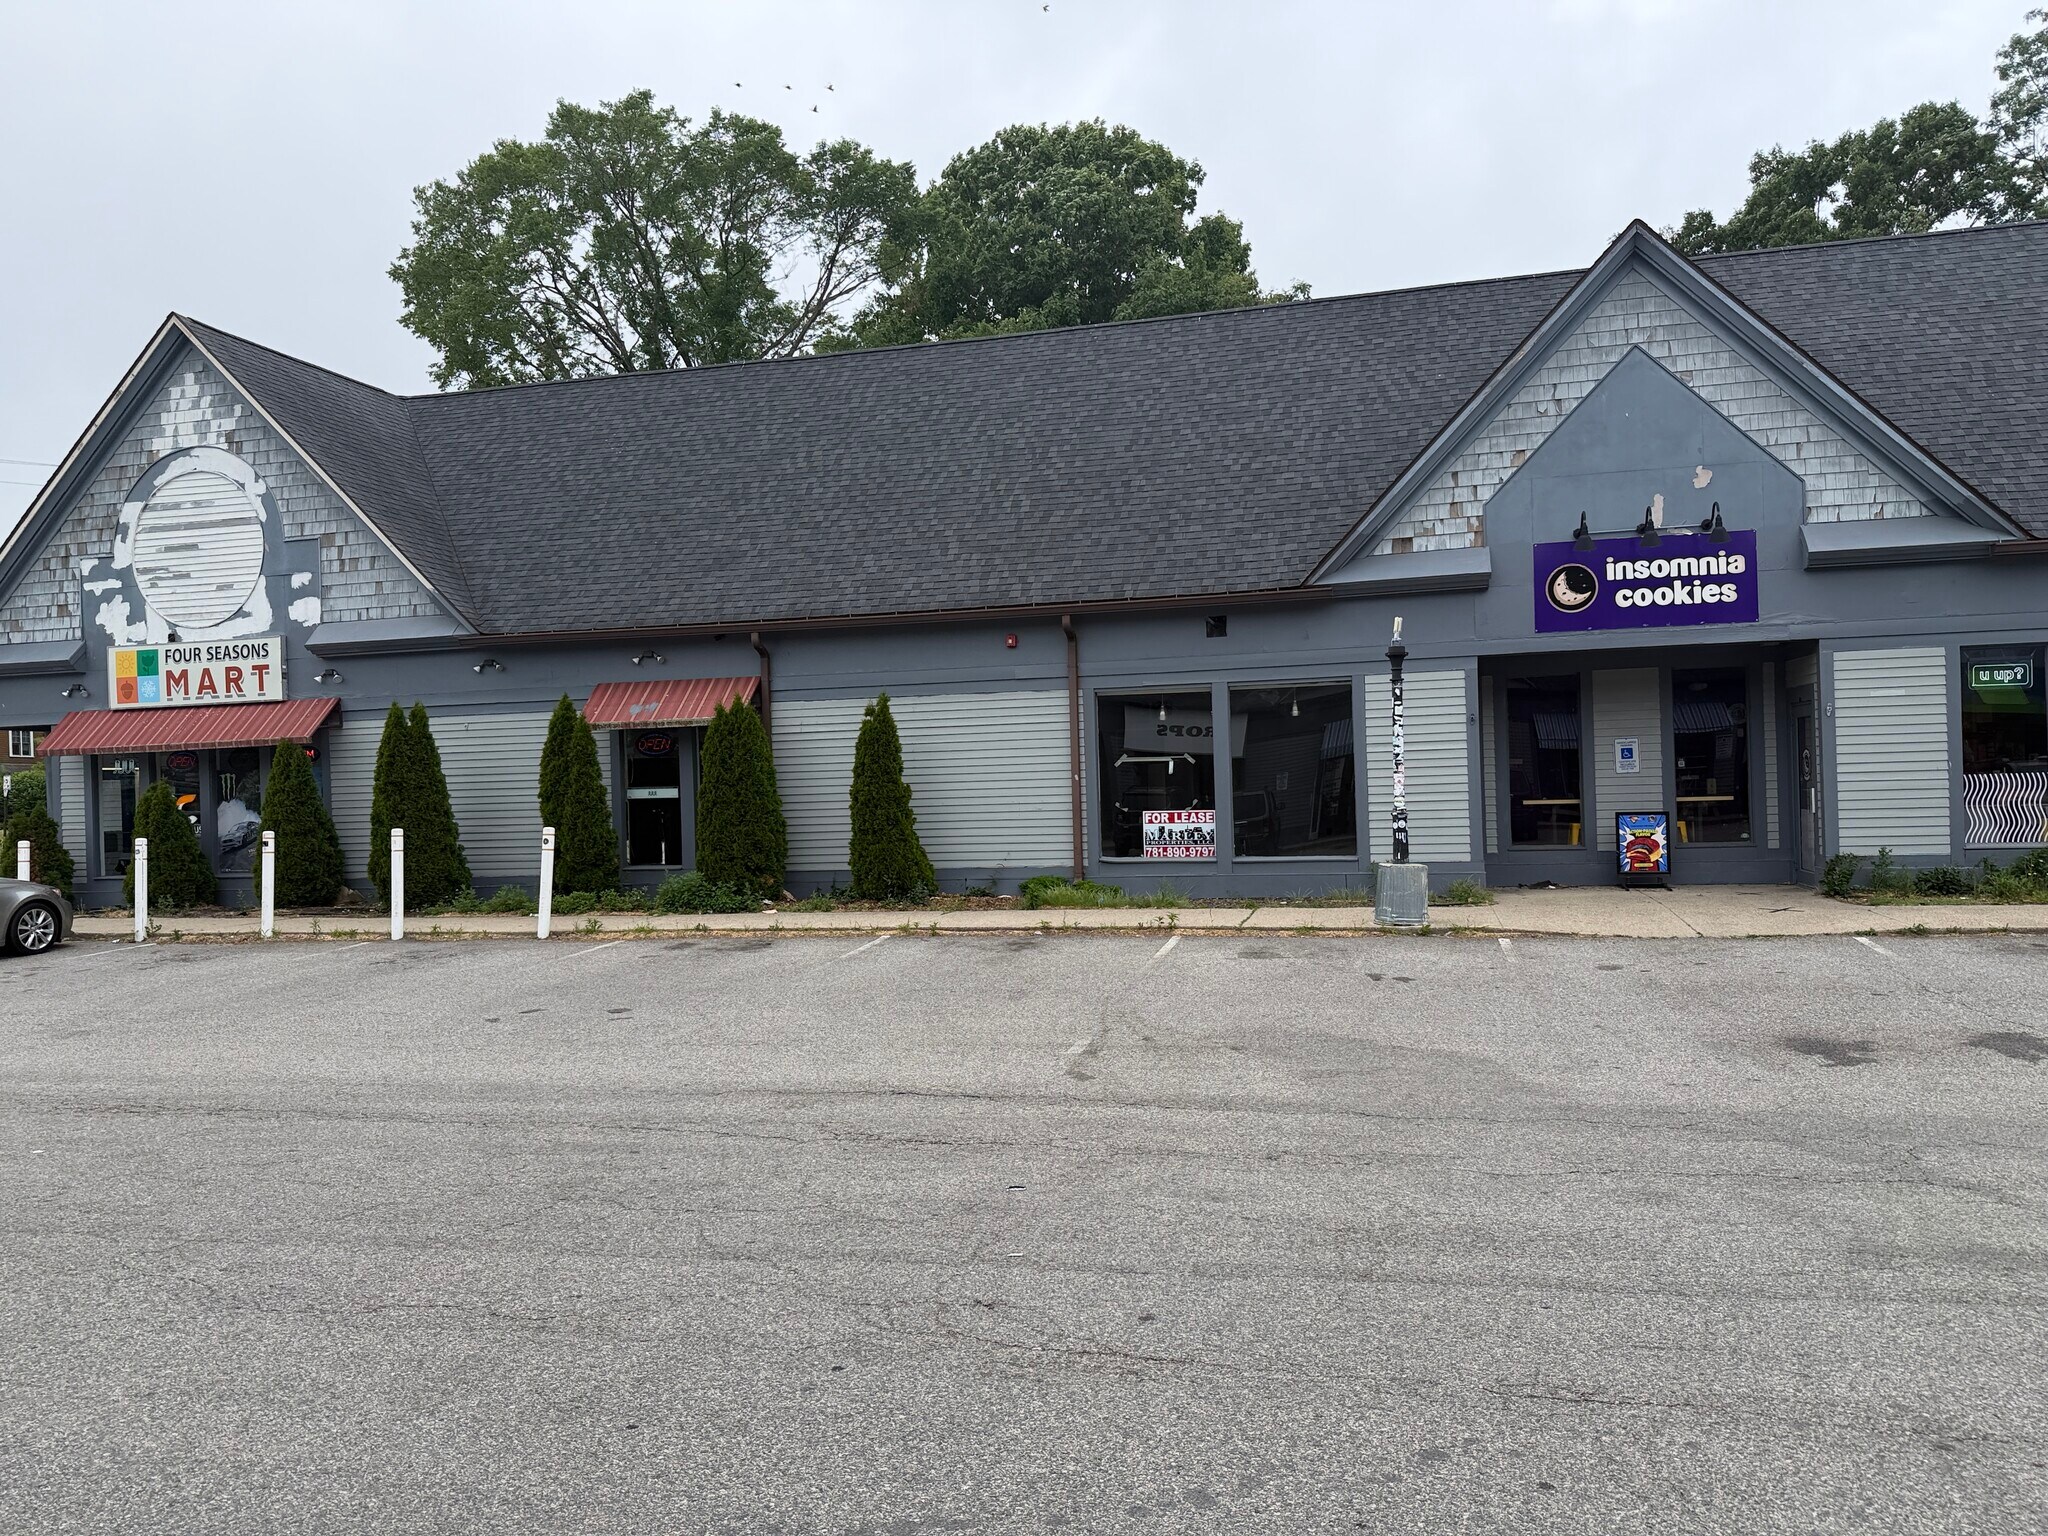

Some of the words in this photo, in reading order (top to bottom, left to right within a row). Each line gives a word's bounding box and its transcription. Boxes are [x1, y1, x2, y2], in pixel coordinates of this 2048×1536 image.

[1606, 550, 1746, 581] insomnia
[1615, 579, 1738, 608] cookies
[165, 647, 202, 664] FOUR
[206, 642, 269, 661] SEASONS
[165, 664, 270, 699] MART
[1979, 670, 1990, 681] u
[1993, 666, 2024, 683] up?
[638, 738, 672, 750] OPEN
[168, 756, 195, 768] OPEN
[1145, 813, 1169, 823] FOR
[1174, 812, 1214, 823] LEASE
[1145, 829, 1214, 840] MARLEY
[1146, 847, 1215, 858] 781-890-9797
